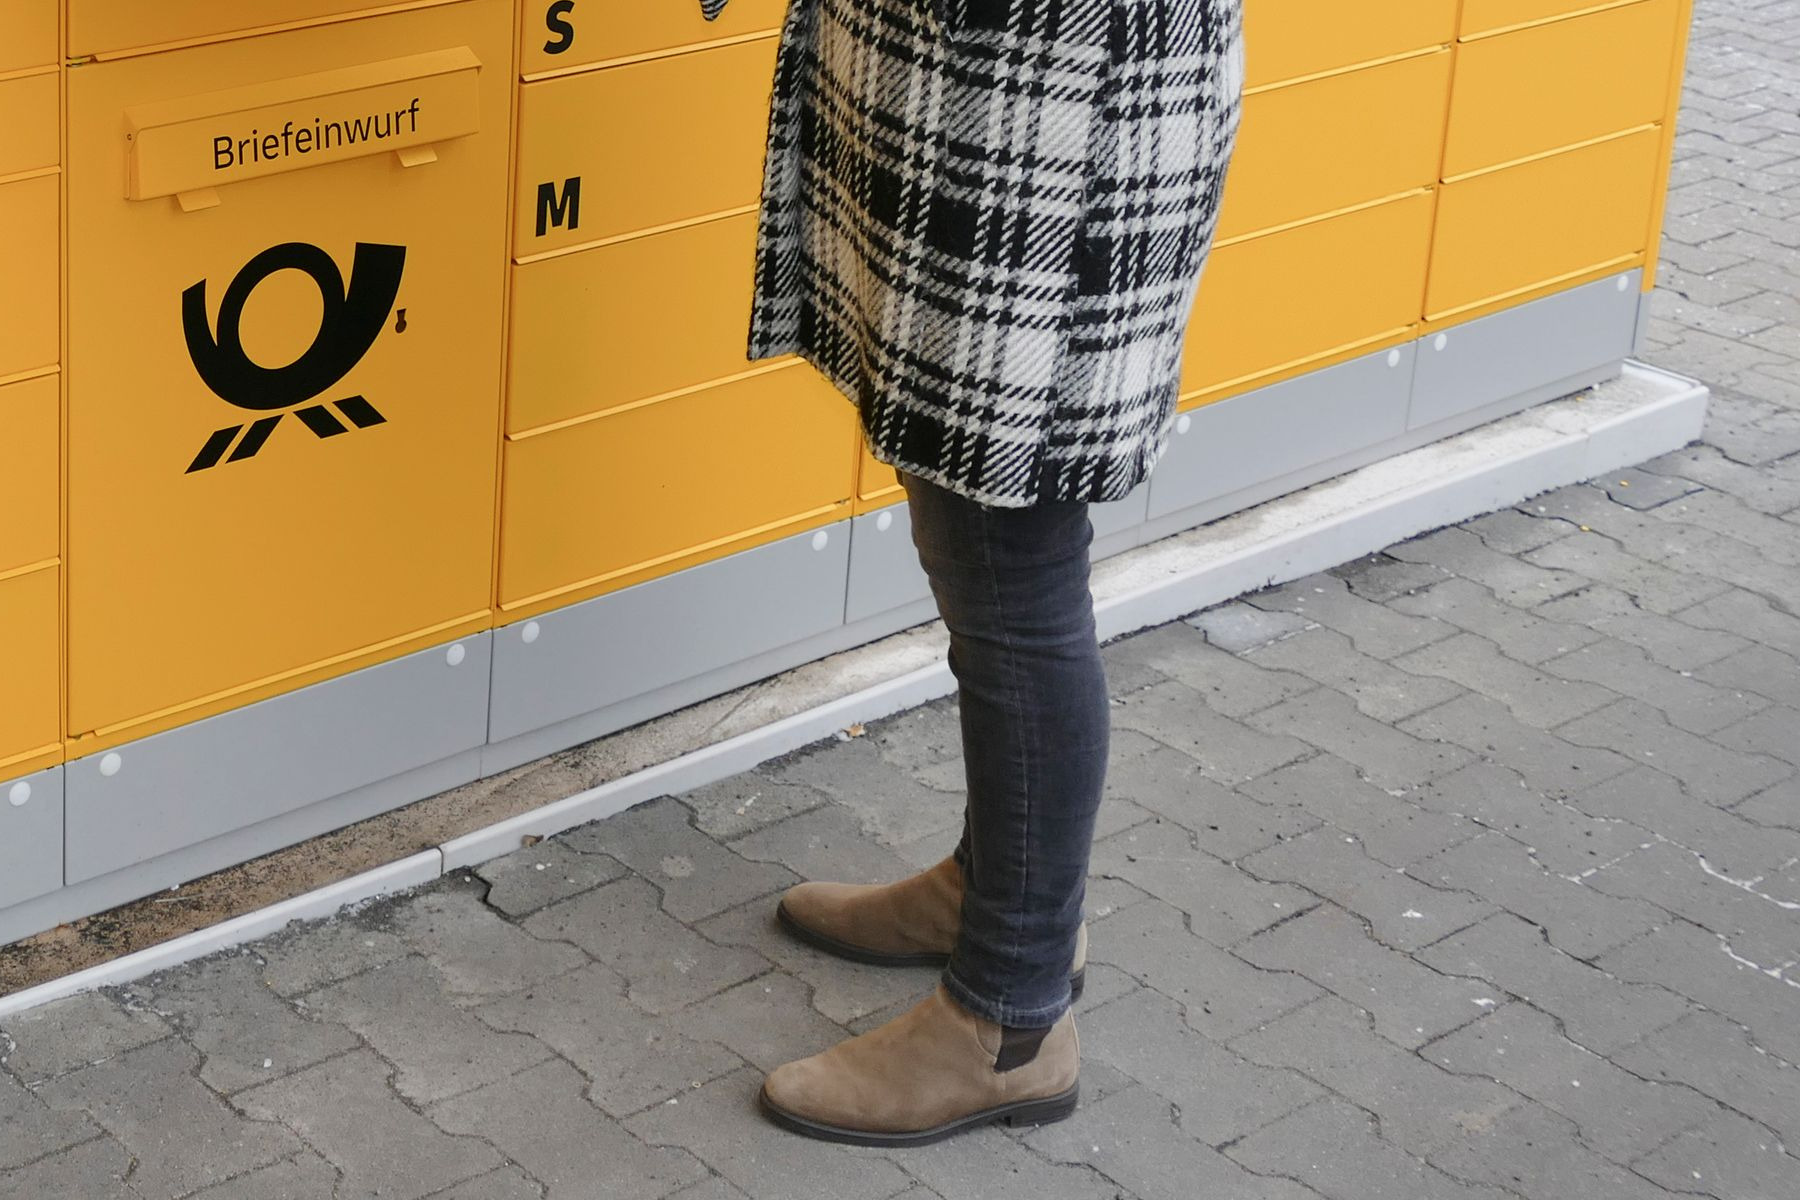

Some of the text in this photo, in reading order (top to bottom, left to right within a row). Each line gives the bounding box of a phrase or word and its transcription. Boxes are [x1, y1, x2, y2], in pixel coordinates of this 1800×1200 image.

[542, 0, 575, 55] S
[213, 97, 421, 170] Briefeinwurf
[535, 176, 581, 238] M
